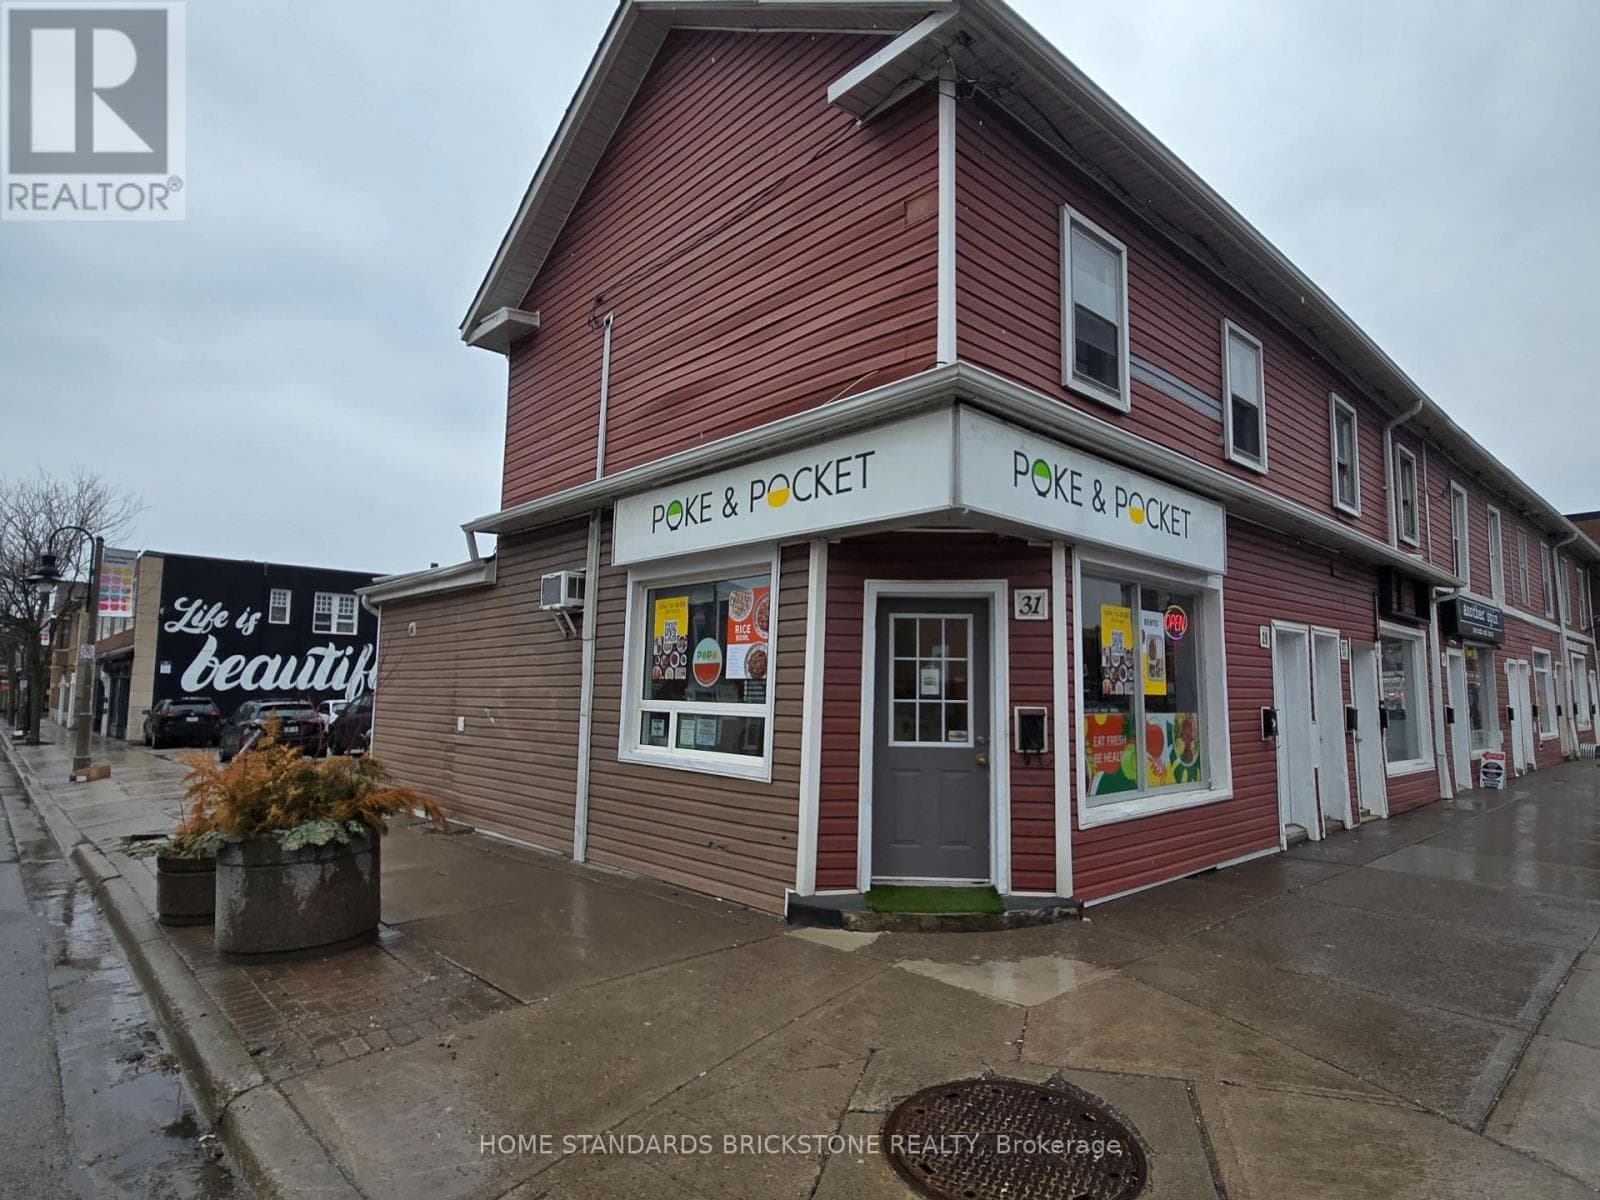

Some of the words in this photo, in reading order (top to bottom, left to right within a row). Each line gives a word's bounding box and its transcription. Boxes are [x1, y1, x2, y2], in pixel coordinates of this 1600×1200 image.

[652, 490, 713, 533] POKE
[722, 486, 738, 518] &
[750, 450, 875, 512] POCKET
[1013, 450, 1083, 507] POKE
[1092, 478, 1106, 514] &
[1115, 485, 1191, 539] POCKET
[1019, 595, 1042, 615] 31
[164, 596, 229, 634] Life
[235, 606, 262, 635] is
[1164, 613, 1186, 632] OPEN
[735, 624, 751, 634] RICE
[1093, 735, 1105, 748] EAT
[1106, 734, 1127, 746] FRESH
